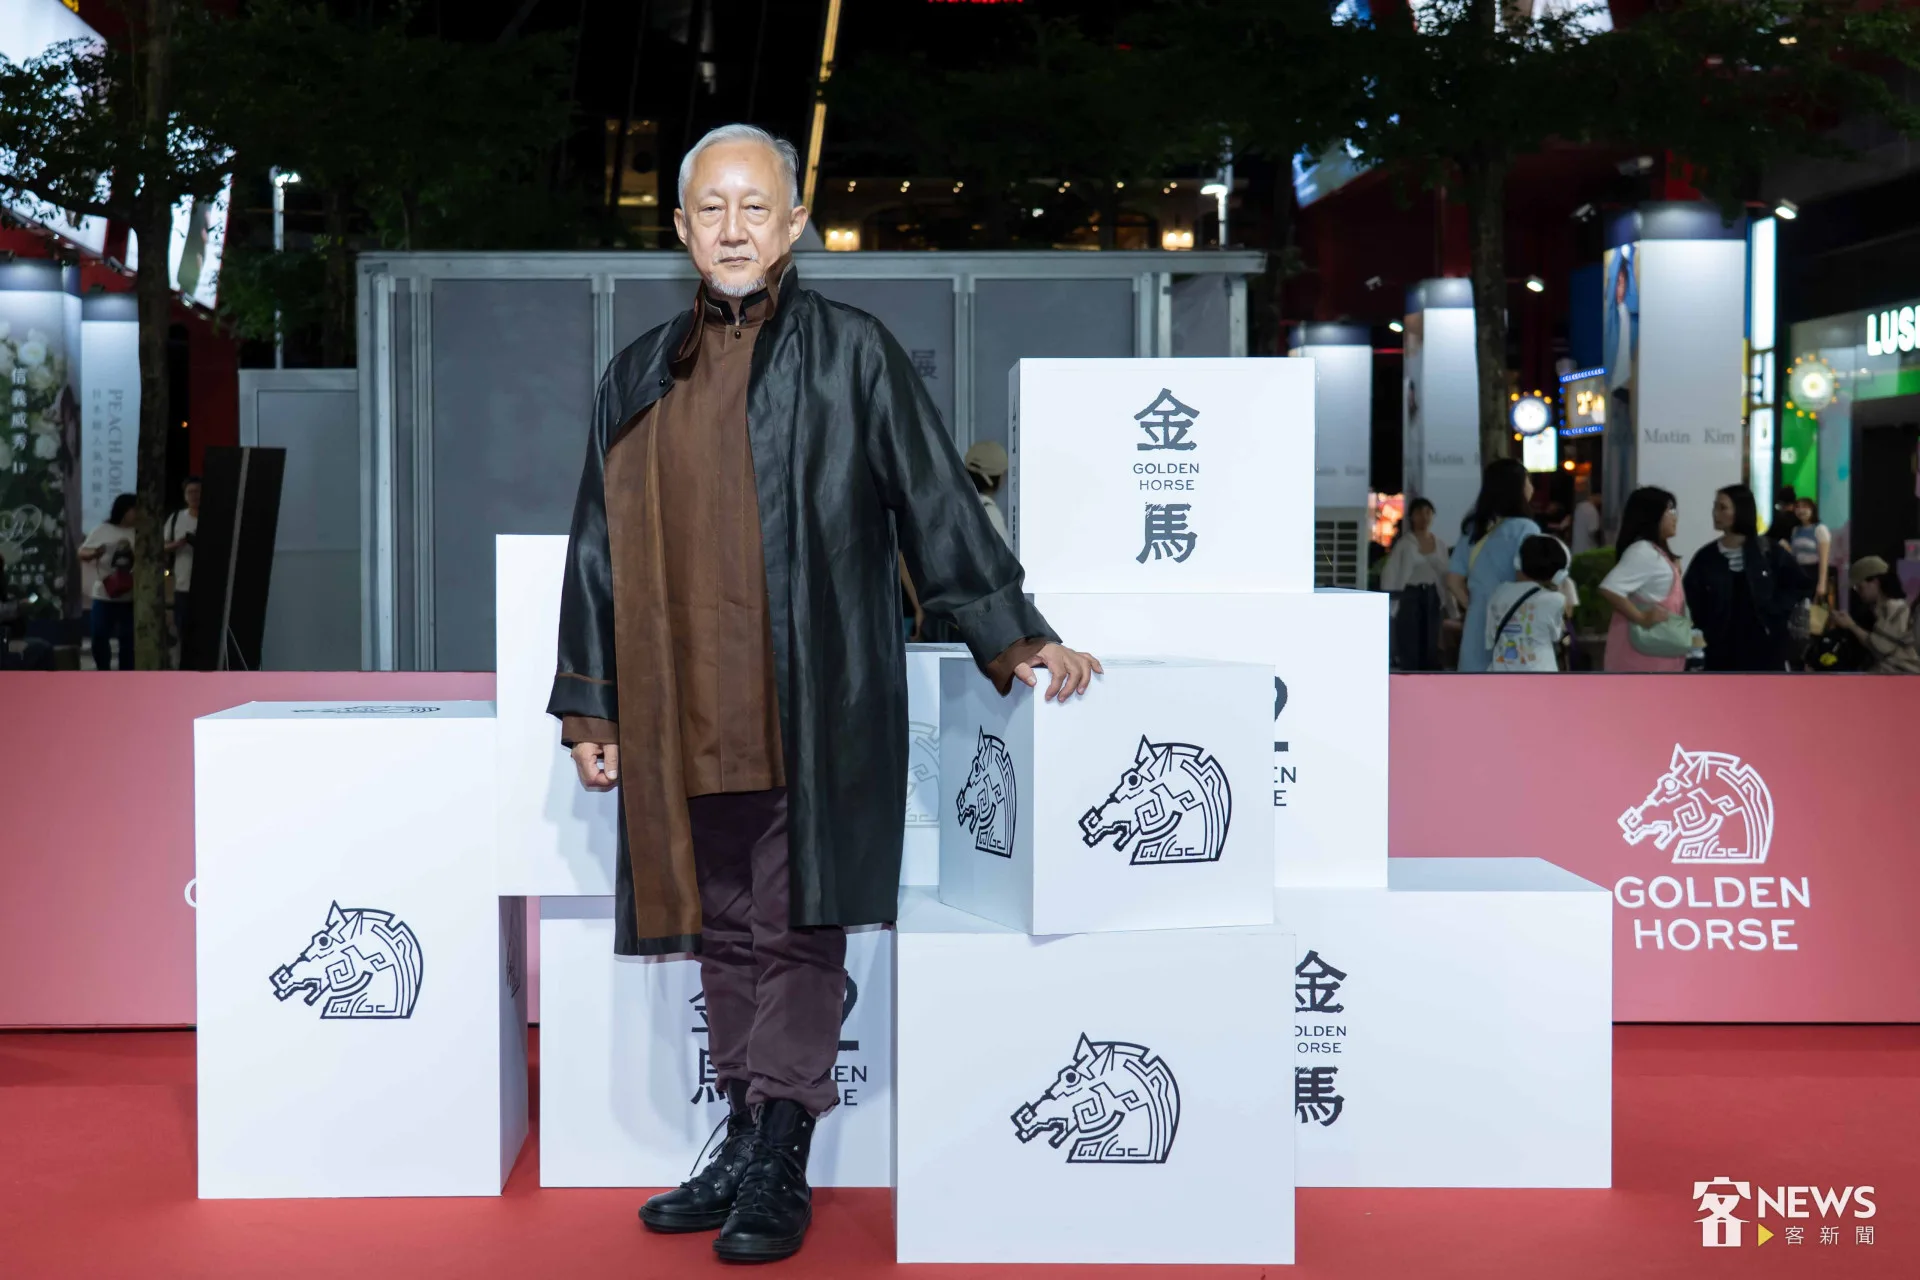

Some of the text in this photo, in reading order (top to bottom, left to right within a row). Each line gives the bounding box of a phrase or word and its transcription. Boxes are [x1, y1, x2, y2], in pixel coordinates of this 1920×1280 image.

[1133, 388, 1201, 451] 金
[1703, 427, 1736, 444] Kim
[108, 389, 124, 500] PEACH JOH
[1132, 463, 1200, 474] GOLDEN
[1139, 479, 1195, 491] HORSE
[1135, 502, 1198, 564] 馬
[1614, 875, 1810, 909] GOLDEN
[1633, 918, 1798, 951] HORSE
[1295, 950, 1348, 1013] 金
[1295, 1025, 1347, 1037] OLDEN
[1297, 1042, 1342, 1053] ORSE
[1295, 1066, 1345, 1127] 馬
